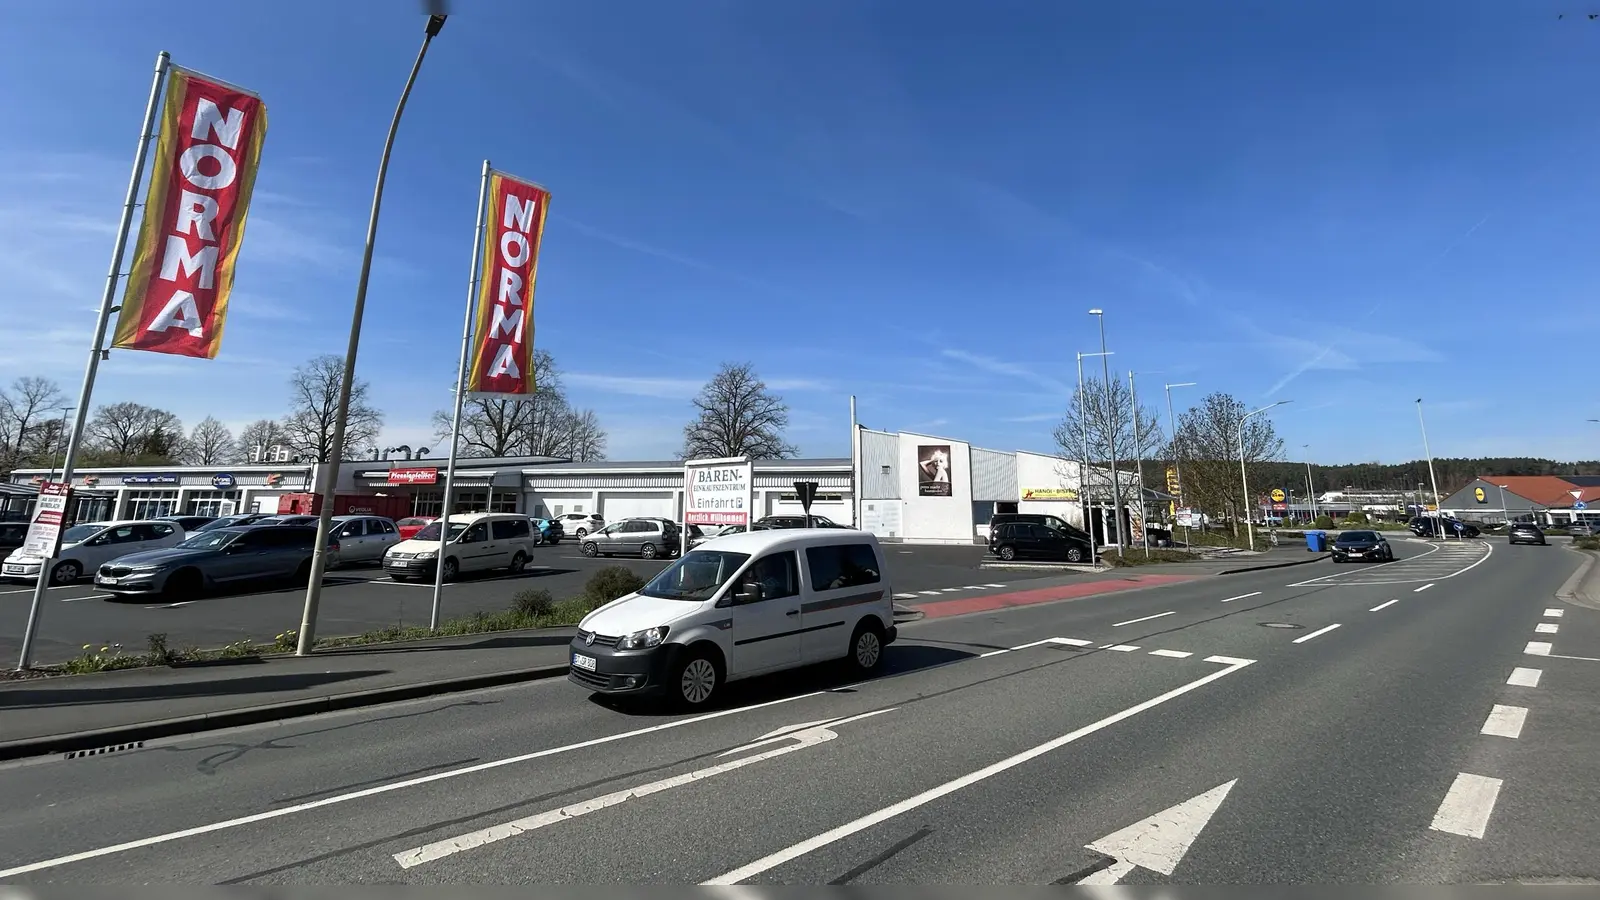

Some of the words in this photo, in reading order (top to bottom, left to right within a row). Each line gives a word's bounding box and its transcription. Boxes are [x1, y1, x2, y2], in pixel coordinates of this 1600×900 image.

[147, 97, 245, 338] NORMA
[486, 193, 536, 379] NORMA
[698, 467, 742, 482] BÄREN-
[693, 483, 746, 492] EINKAUFSZENTRUM
[697, 497, 735, 509] Einfahrt
[688, 513, 709, 522] Herzlich
